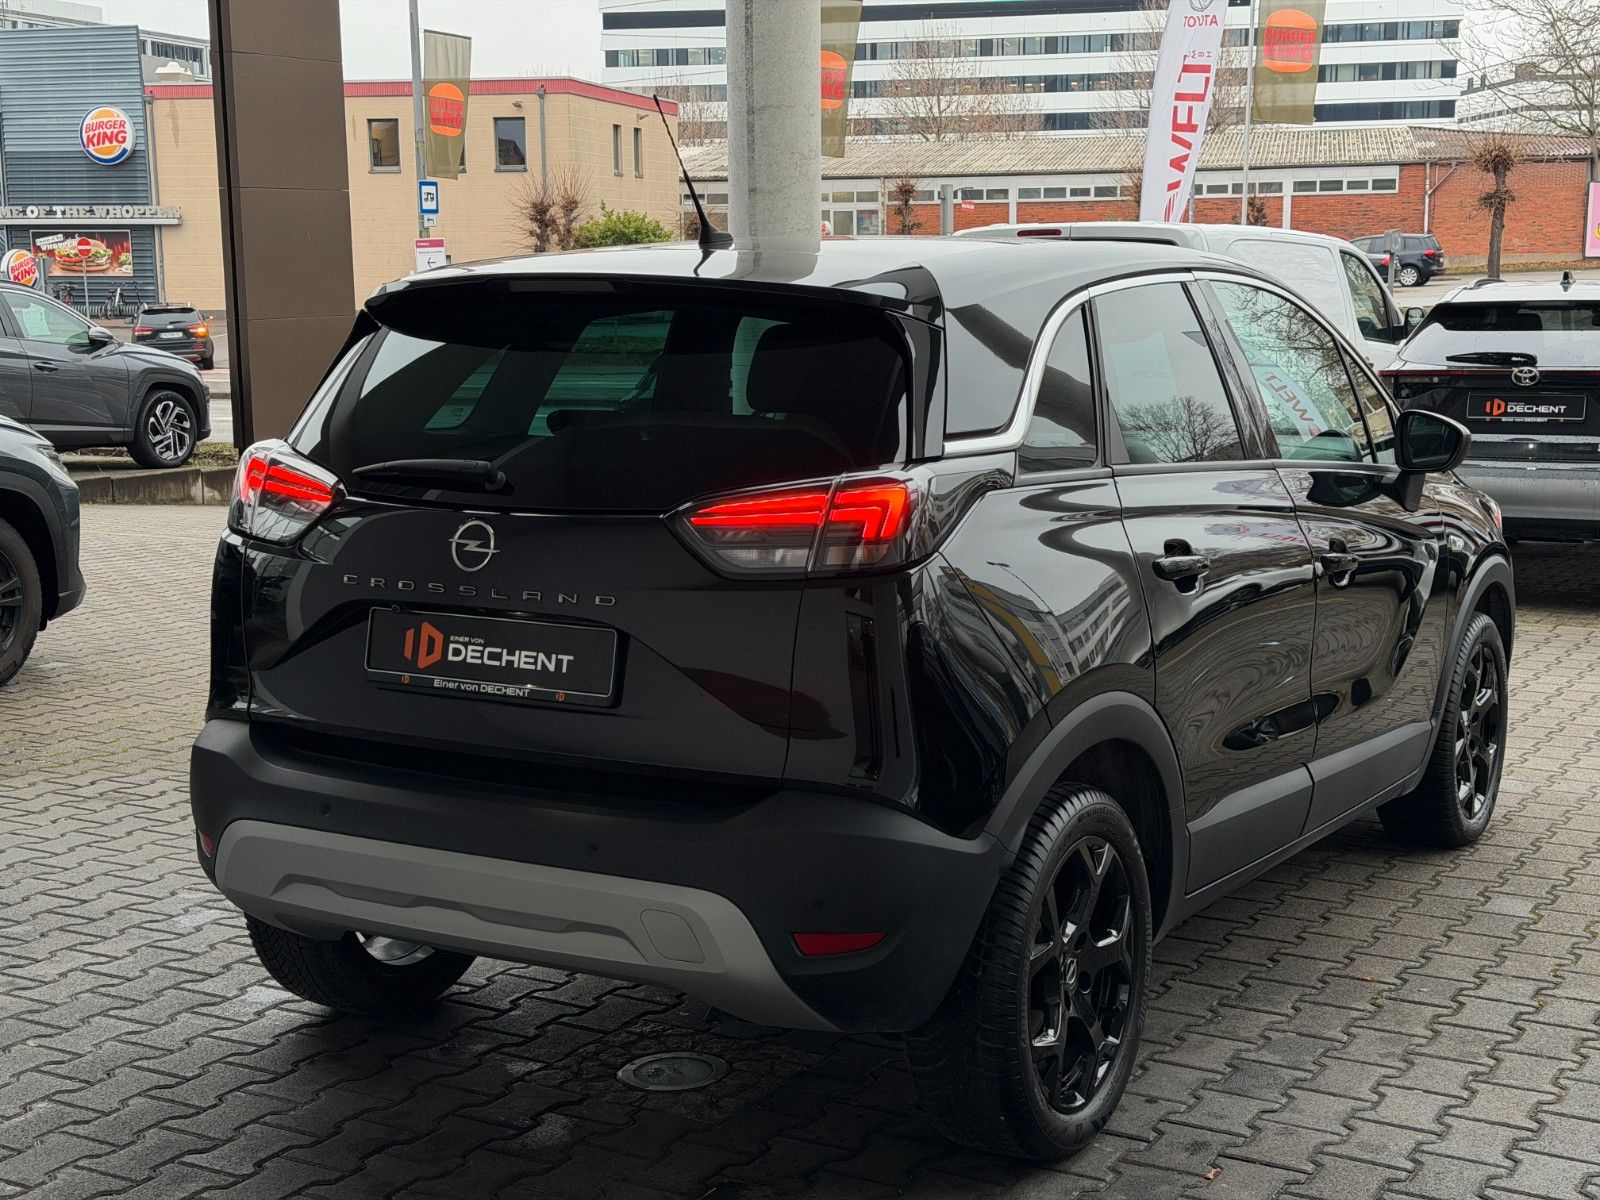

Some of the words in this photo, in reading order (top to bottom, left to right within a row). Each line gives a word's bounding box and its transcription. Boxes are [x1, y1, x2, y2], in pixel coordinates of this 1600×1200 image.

[1263, 42, 1313, 62] KING
[85, 120, 127, 134] BURGER
[86, 130, 128, 148] KING
[26, 205, 49, 219] OF
[53, 206, 92, 218] THE
[93, 206, 181, 219] WHOPPER
[11, 257, 36, 274] BURGER
[13, 264, 36, 281] KING
[1507, 405, 1567, 413] DECHENT
[343, 573, 617, 606] CROSSLAND
[450, 635, 469, 643] EINER
[447, 643, 574, 674] DECHENT
[433, 679, 459, 689] Einer
[461, 683, 479, 692] von
[480, 684, 530, 698] DECHENT
